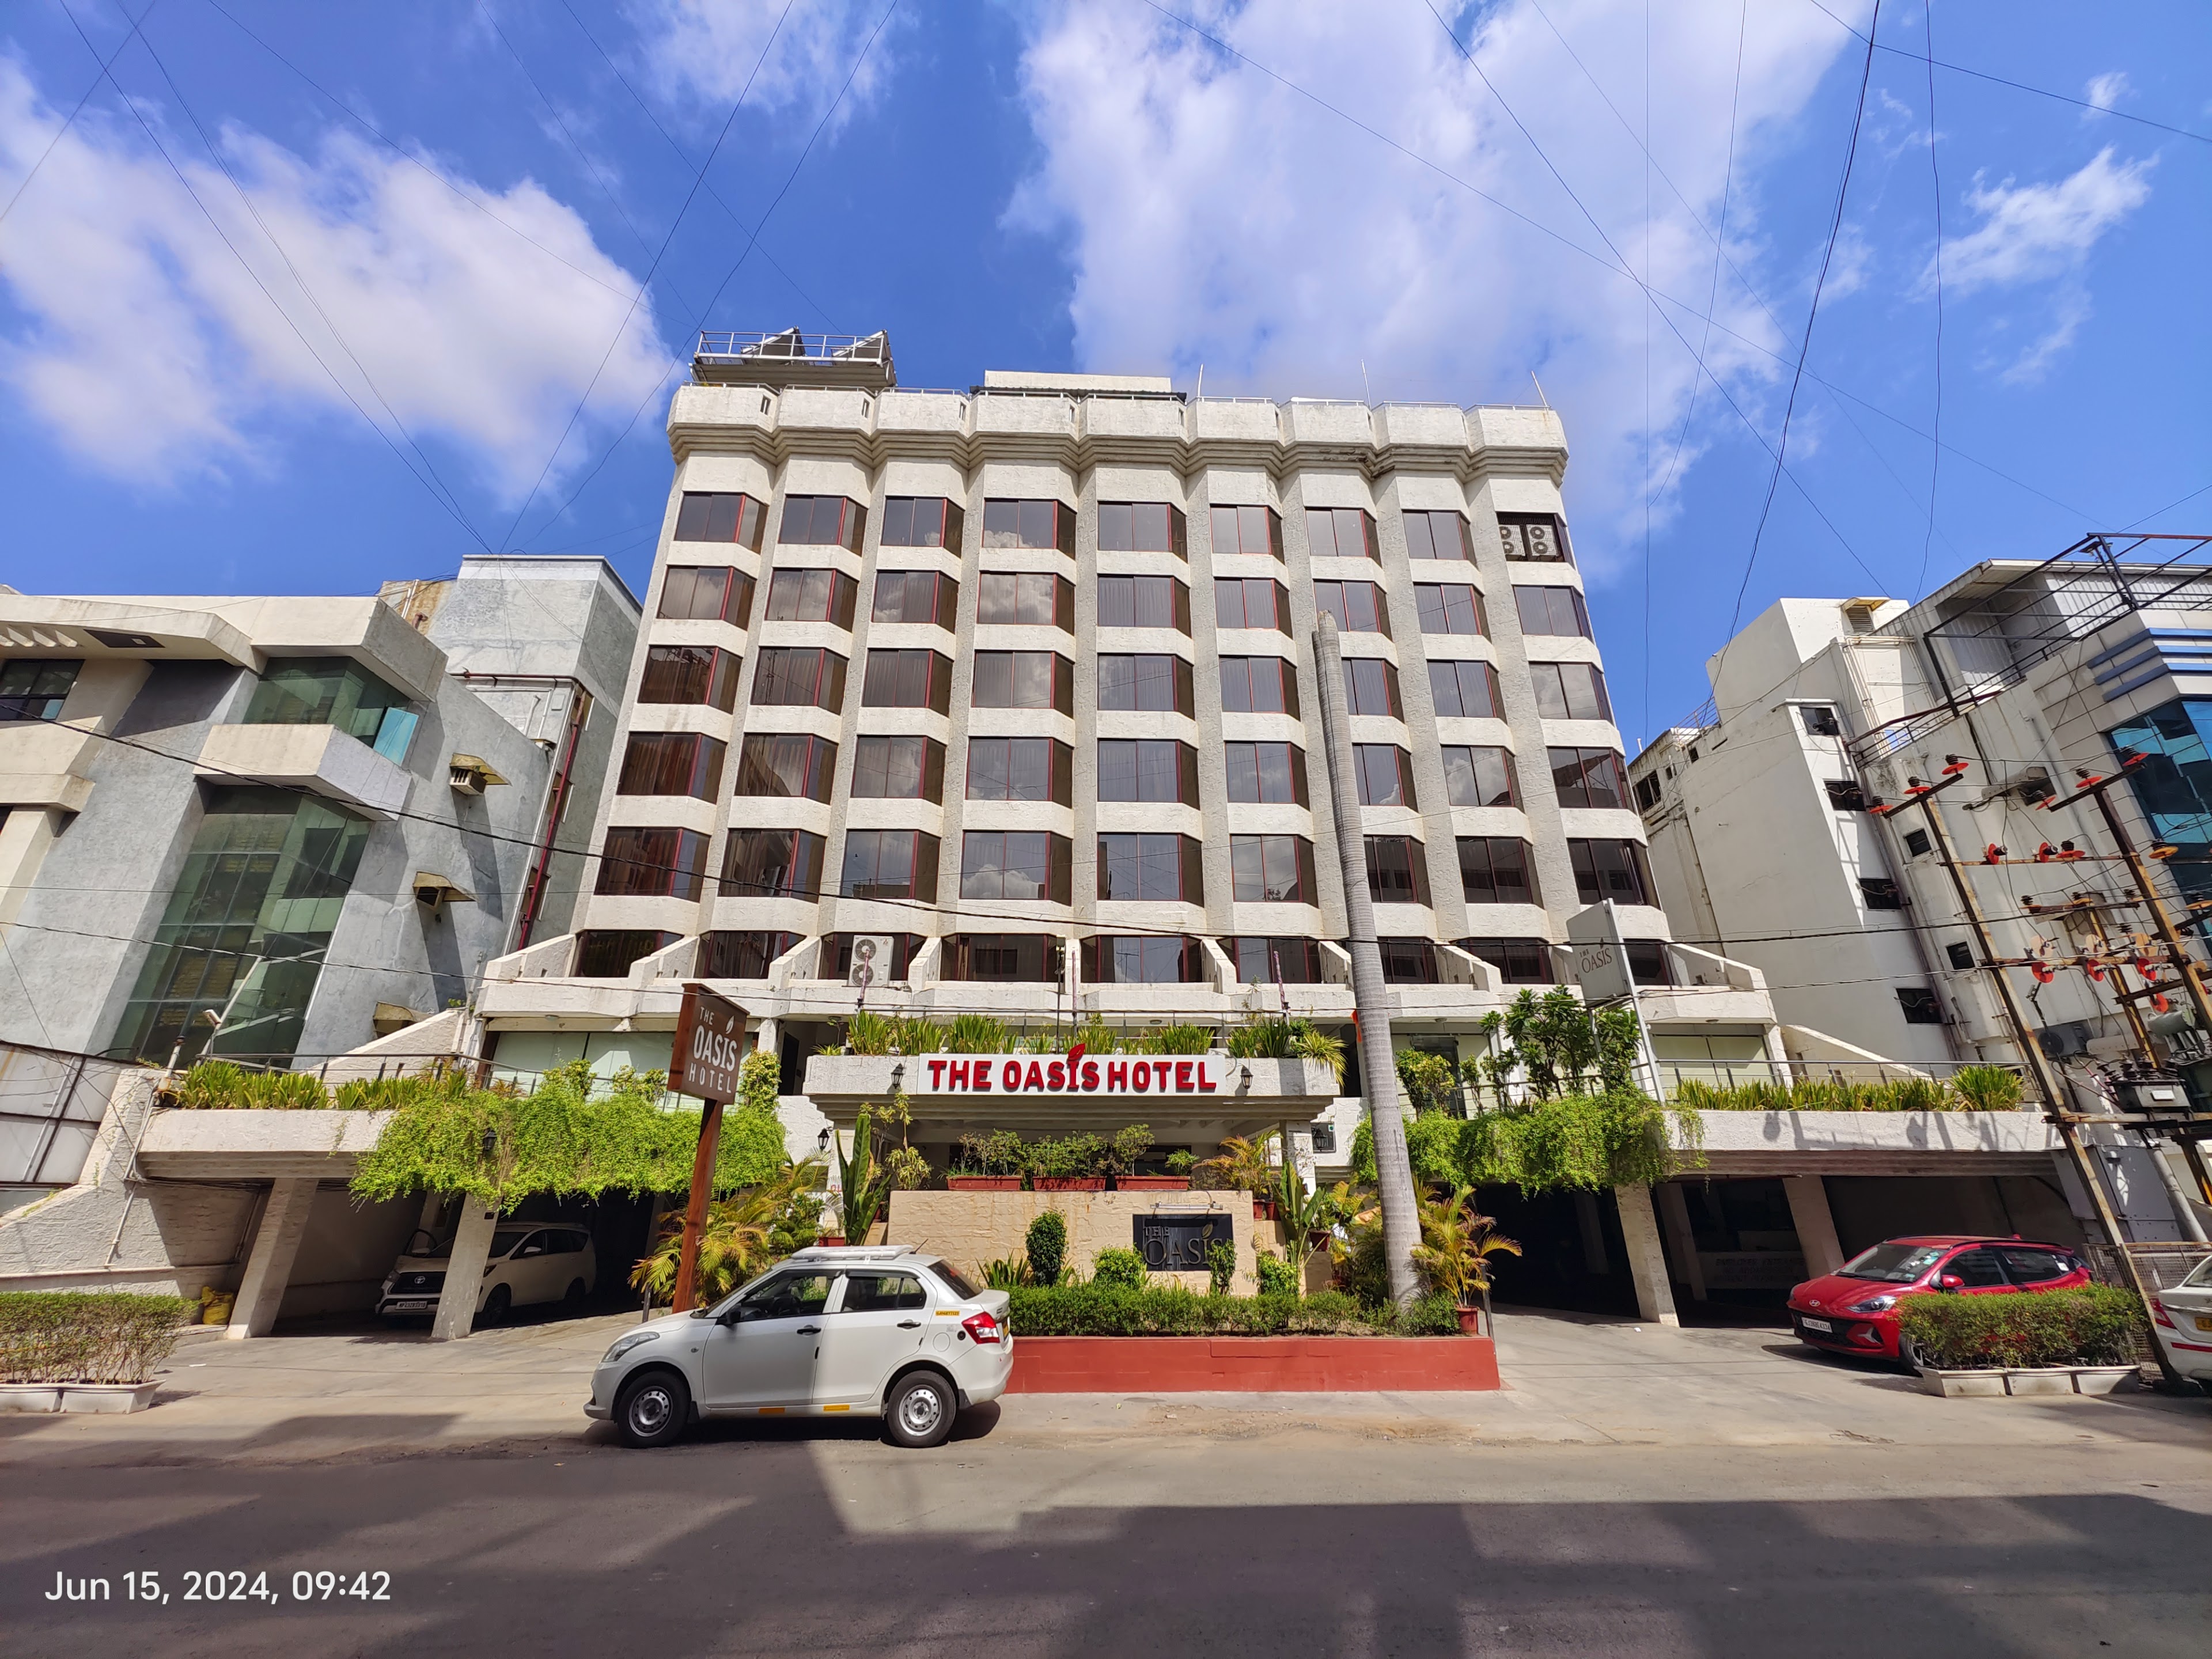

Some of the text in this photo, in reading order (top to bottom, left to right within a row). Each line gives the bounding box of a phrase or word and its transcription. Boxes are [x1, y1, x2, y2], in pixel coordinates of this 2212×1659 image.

[1581, 948, 1612, 973] OASIS
[699, 1006, 714, 1025] THE
[694, 1025, 737, 1071] OASIS
[688, 1062, 732, 1093] HOTEL
[928, 1059, 1217, 1089] THE OASIS HOTEL
[1143, 1226, 1170, 1236] THE
